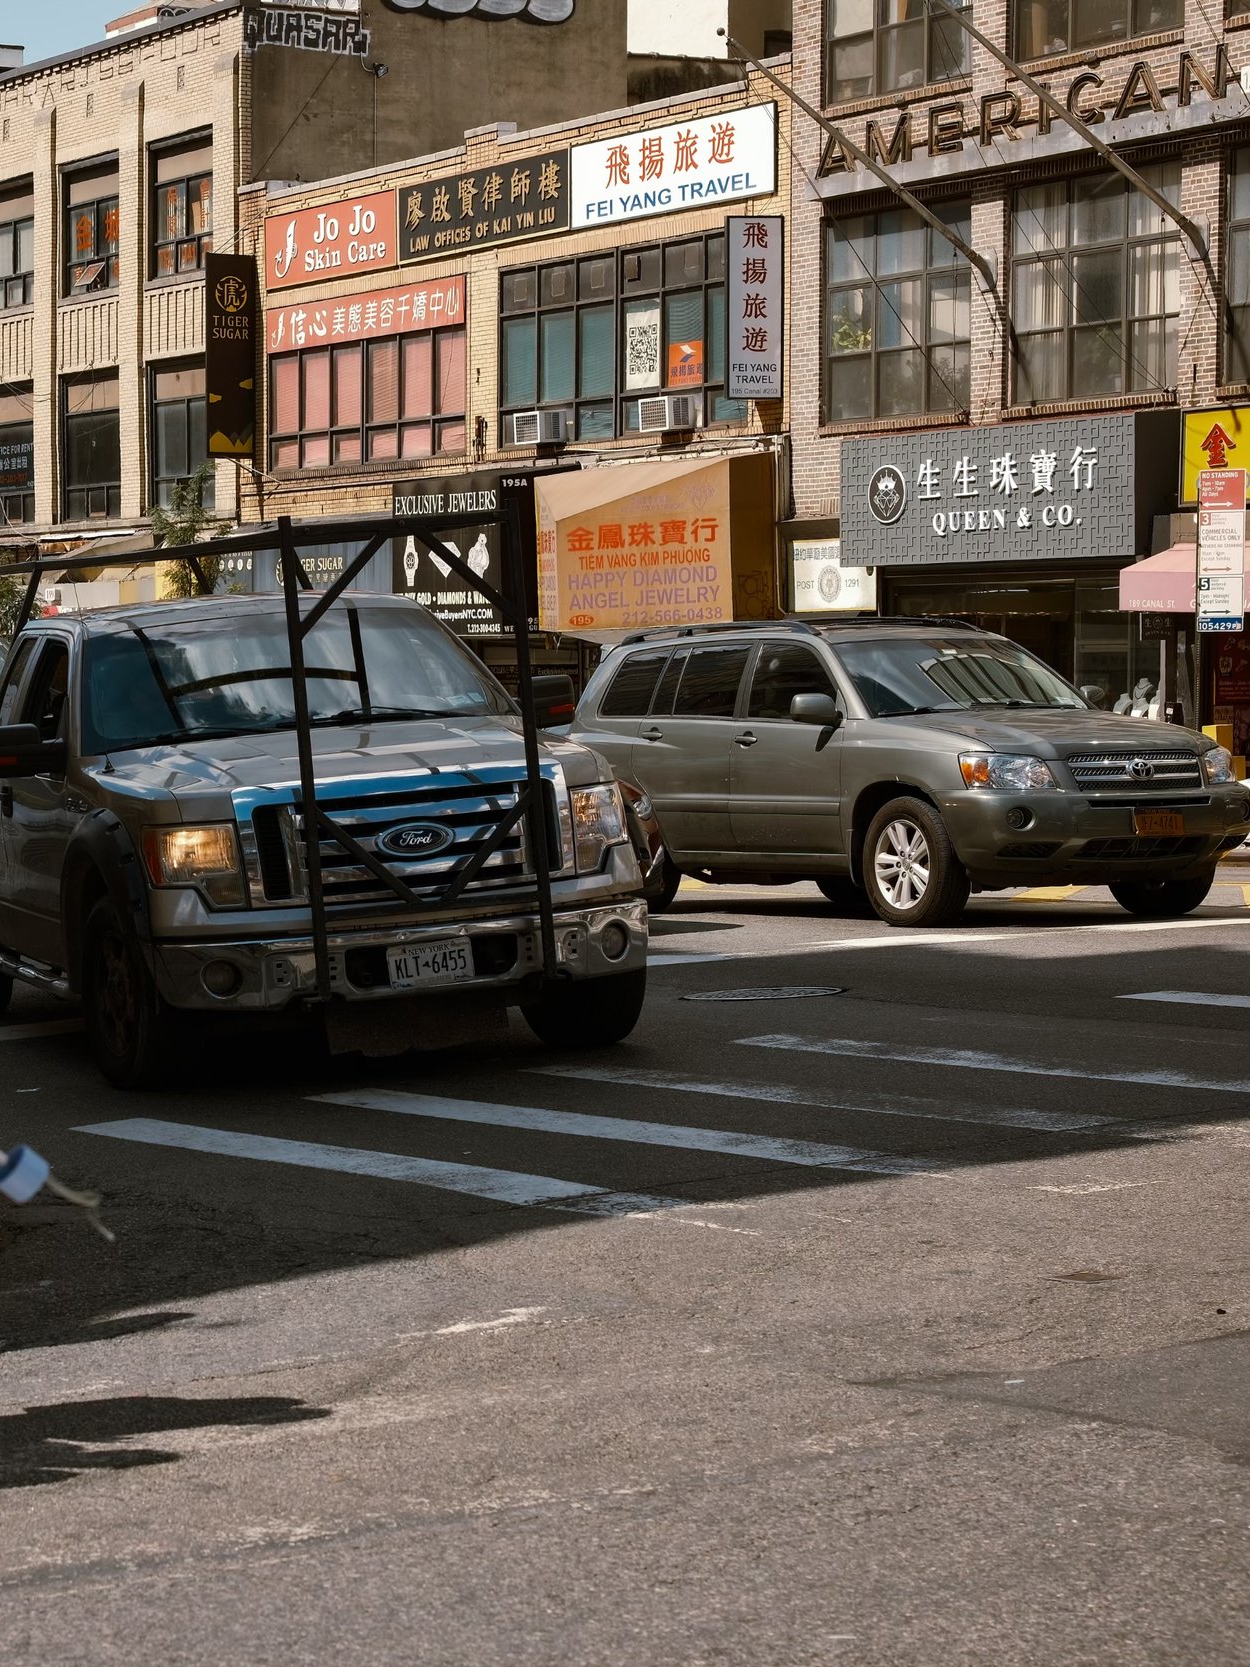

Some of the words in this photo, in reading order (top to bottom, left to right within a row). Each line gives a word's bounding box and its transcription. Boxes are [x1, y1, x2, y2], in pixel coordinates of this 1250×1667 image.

[815, 43, 1228, 180] AMERICAN
[605, 121, 735, 189] 飛揚旅遊
[586, 199, 613, 219] FEI
[619, 188, 671, 212] YANG
[678, 172, 757, 201] TRAVEL
[313, 213, 339, 244] Jo
[349, 205, 376, 237] Jo
[410, 233, 430, 253] LAW
[434, 226, 471, 248] OFFICES
[476, 221, 489, 239] OF
[493, 216, 511, 235] KAI
[516, 211, 534, 231] YIN
[538, 206, 555, 225] LIU
[304, 249, 342, 272] Skin
[347, 240, 386, 264] Care
[742, 222, 768, 352] 飛揚旅遊
[212, 315, 249, 327] TIGER
[212, 328, 249, 339] SUGAR
[732, 363, 747, 372] FEI
[750, 363, 777, 372] YANG
[735, 375, 774, 384] TRAVEL
[11, 444, 20, 454] FOR
[21, 443, 33, 453] RENT
[917, 445, 1098, 499] 生生珠寶行
[502, 478, 528, 487] 195A
[395, 494, 444, 516] EXCLUSIVE
[447, 490, 497, 513] JEWELERS
[932, 509, 1007, 536] QUEEN
[1017, 507, 1032, 528] &
[1042, 504, 1082, 527] CO.
[1202, 513, 1209, 525] 3
[566, 518, 719, 552] 金鳳珠寶行
[317, 557, 343, 570] SUGAR
[640, 551, 659, 567] KIM
[568, 571, 628, 590] HAPPY
[633, 565, 717, 587] DIAMOND
[796, 580, 815, 590] POST
[845, 579, 859, 587] 1291
[1200, 578, 1208, 590] 5
[417, 592, 431, 605] GOLD
[437, 591, 466, 605] DIAMONDS
[467, 591, 472, 604] &
[569, 592, 630, 610] ANGEL
[635, 585, 720, 606] JEWELRY
[1129, 600, 1141, 608] 189
[1142, 600, 1164, 608] CANAL
[1167, 600, 1175, 608] ST.
[572, 615, 591, 625] 195
[622, 607, 723, 625] 212-566-0438
[1199, 622, 1232, 630] 105429
[399, 830, 433, 846] Ford
[408, 946, 426, 956] NEW
[427, 942, 451, 953] YORK
[394, 955, 421, 980] KLT
[431, 949, 467, 974] 6455
